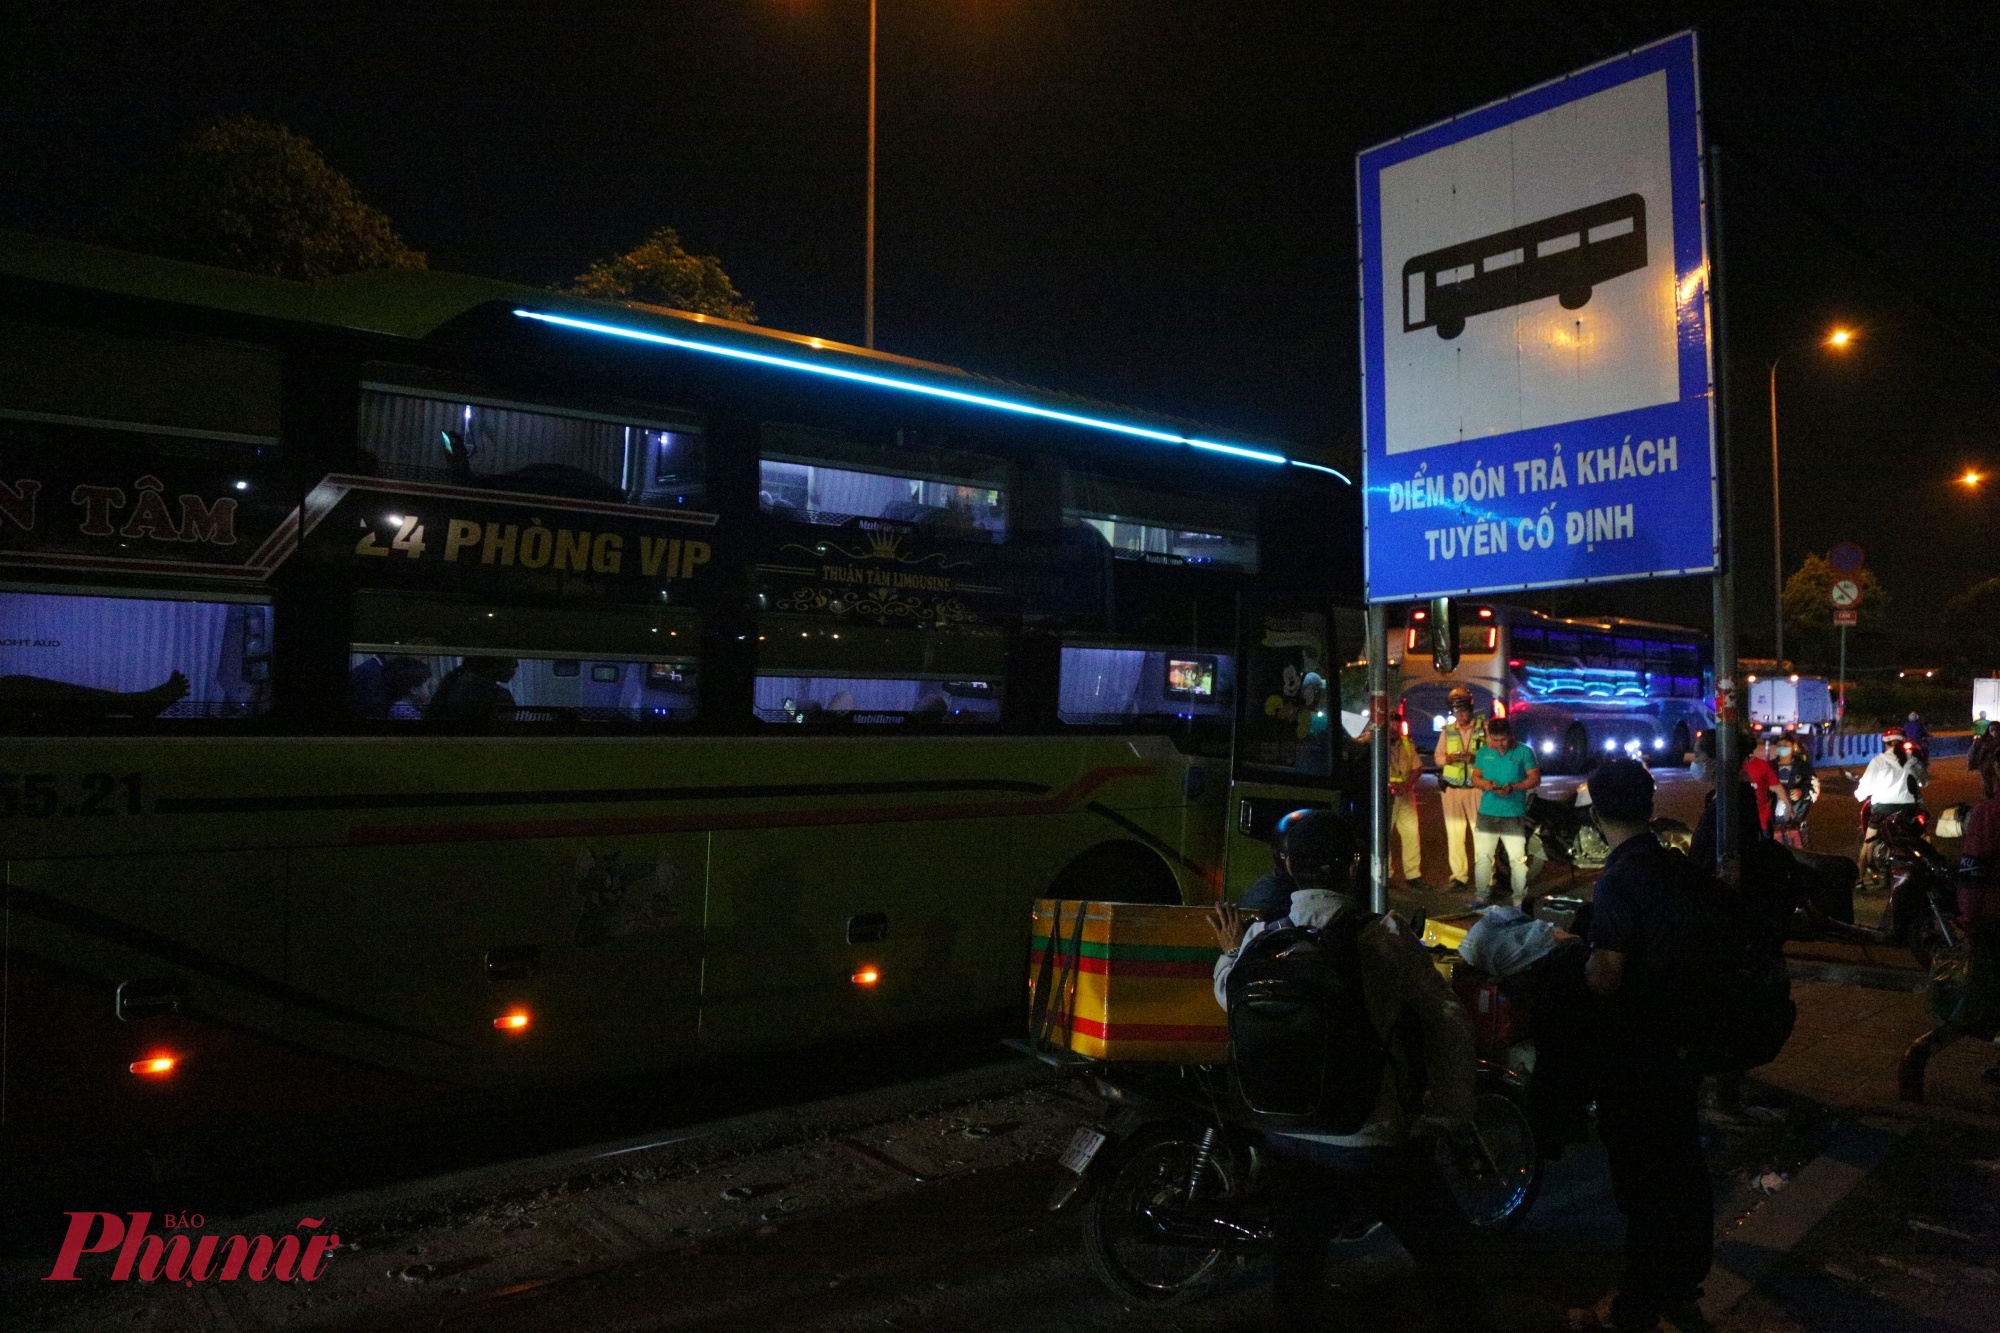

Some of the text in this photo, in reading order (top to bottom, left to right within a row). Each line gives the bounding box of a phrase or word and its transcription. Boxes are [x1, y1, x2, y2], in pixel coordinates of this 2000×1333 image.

[1389, 434, 1678, 513] ĐIỂM ĐÓN TRẢ KHÁCH
[71, 475, 238, 545] TÂM
[1425, 502, 1634, 561] TUYẾN CỐ ĐỊNH
[443, 517, 624, 574] PHÒNG
[639, 536, 712, 579] VIP
[893, 572, 951, 592] LIMOUSINE
